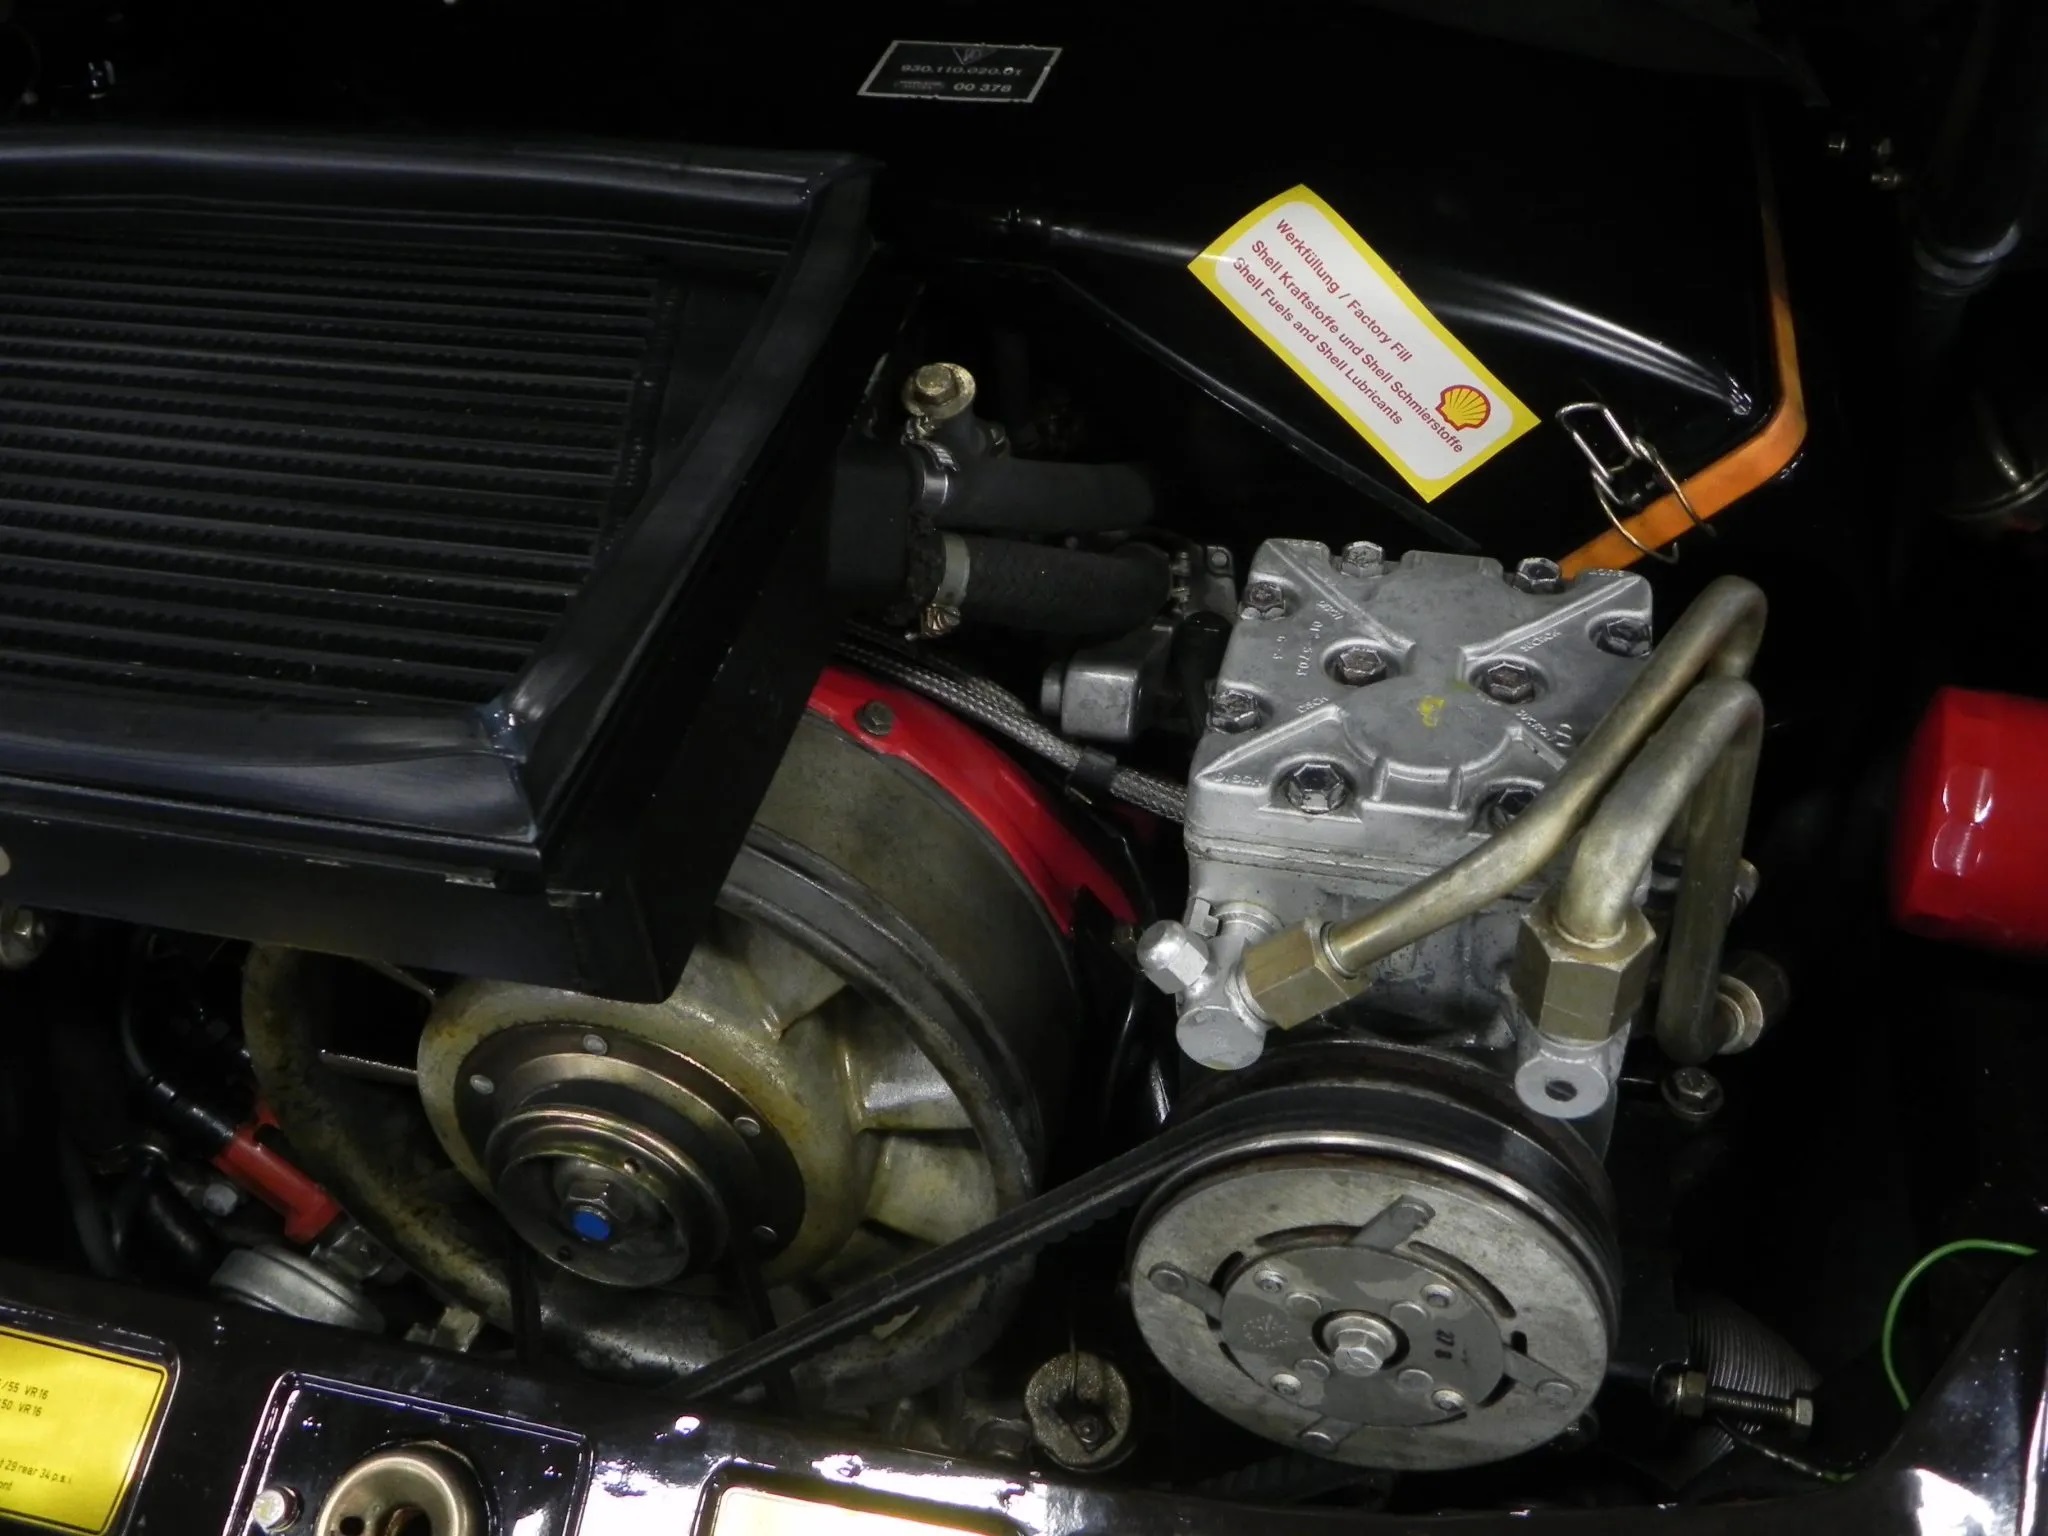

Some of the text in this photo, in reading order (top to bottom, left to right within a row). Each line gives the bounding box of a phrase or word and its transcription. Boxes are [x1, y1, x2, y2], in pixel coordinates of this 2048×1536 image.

[979, 84, 1012, 93] 378
[1233, 257, 1403, 425] Shell Fuels and Shell Lubricants
[1252, 240, 1463, 453] Shell Kraftstoffe und Shell Schmierstoffe
[1276, 218, 1340, 294] Werkfüllung
[1347, 300, 1392, 344] Factory
[1390, 342, 1413, 362] Fill
[0, 1378, 20, 1393] /55
